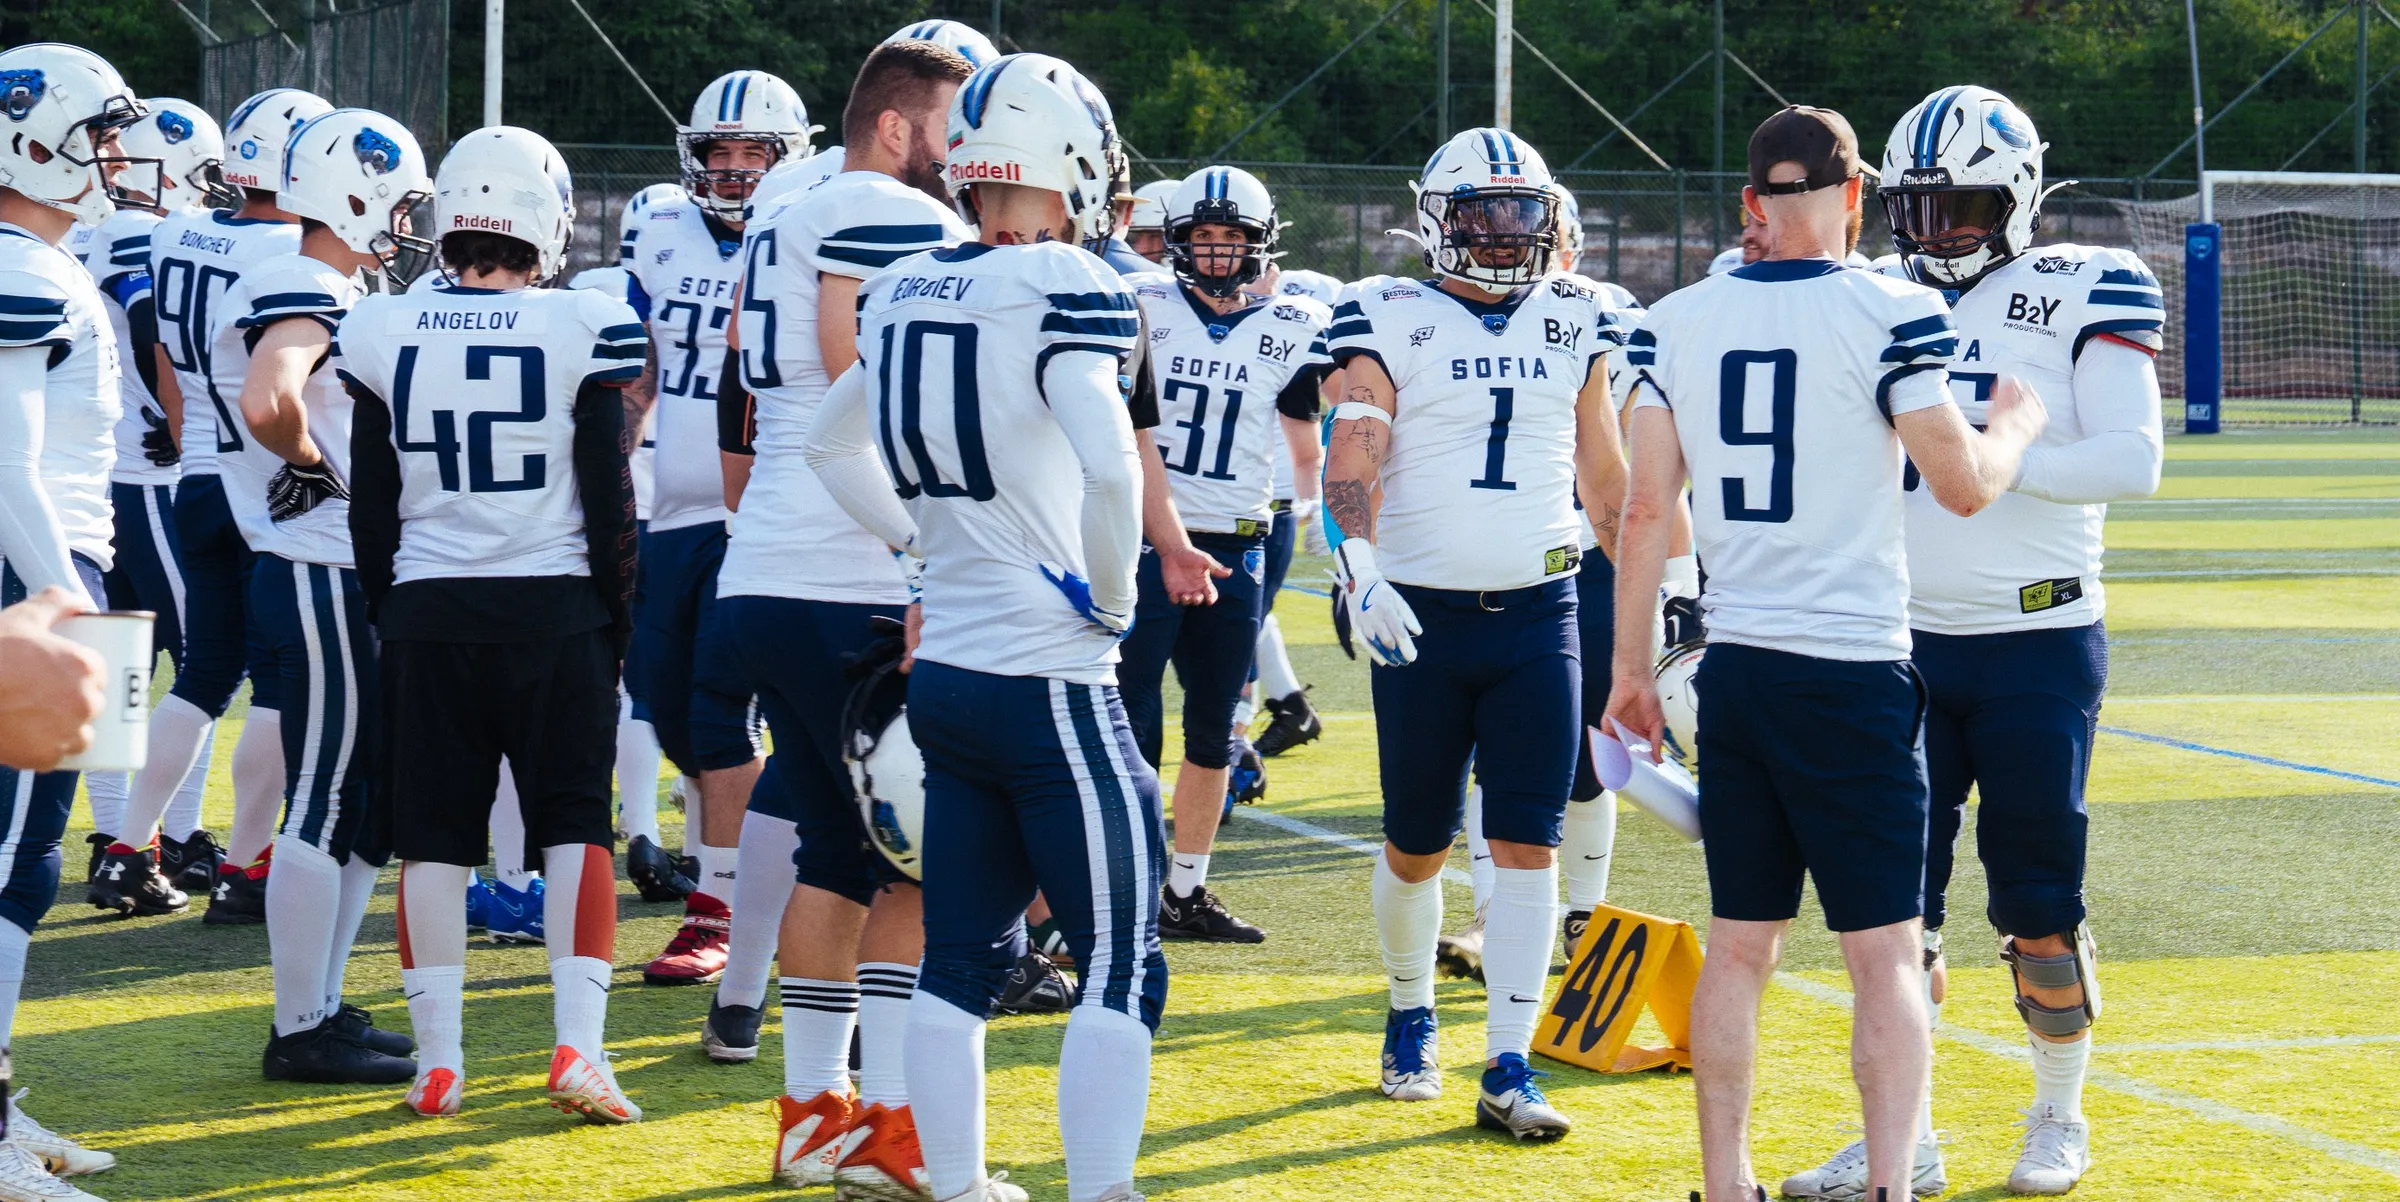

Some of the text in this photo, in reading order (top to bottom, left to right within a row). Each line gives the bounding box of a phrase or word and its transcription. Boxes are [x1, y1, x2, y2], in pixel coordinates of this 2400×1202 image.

[949, 161, 1021, 181] Riddell
[1490, 176, 1526, 184] Riddell
[1903, 173, 1946, 185] Riddell
[453, 215, 512, 232] Riddell
[179, 229, 237, 256] BONCHEV
[679, 277, 738, 300] SOFI
[416, 311, 519, 330] ANGELOV
[2007, 293, 2062, 326] B2Y
[1544, 318, 1582, 351] B2Y
[2003, 322, 2057, 338] PRODUCTIONS
[1258, 334, 1296, 362] B2Y
[1171, 356, 1249, 383] SOFIA
[1452, 357, 1548, 380] SOFIA
[392, 345, 546, 492] 42
[879, 320, 996, 501] 10
[1157, 378, 1243, 480] 31
[1470, 388, 1516, 490] 1
[1720, 349, 1797, 523] 9
[2061, 592, 2073, 601] XL
[1551, 918, 1648, 1054] 40
